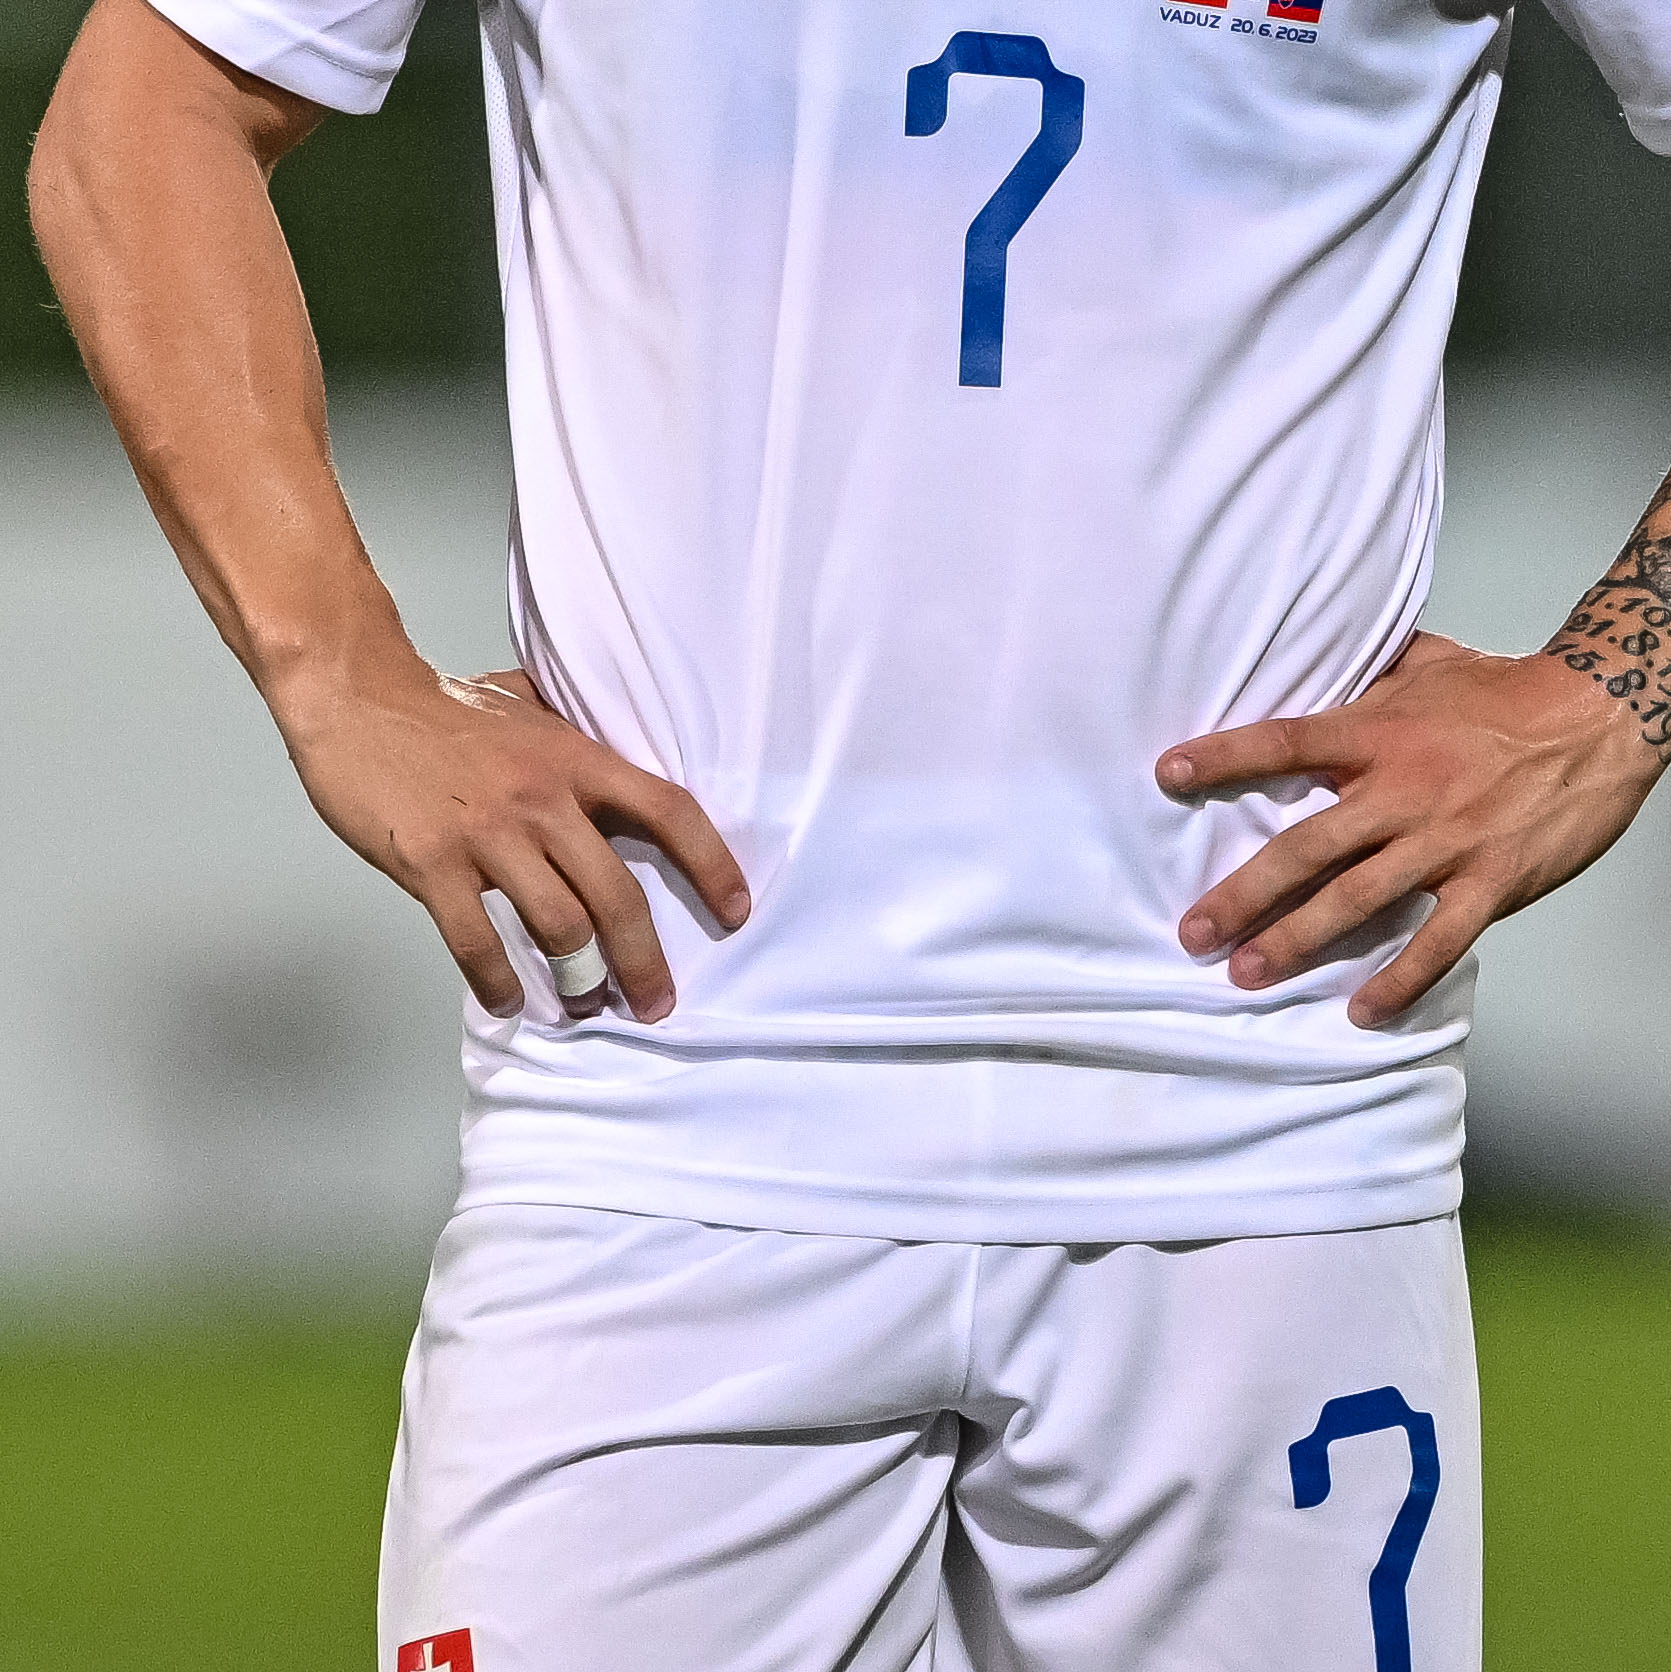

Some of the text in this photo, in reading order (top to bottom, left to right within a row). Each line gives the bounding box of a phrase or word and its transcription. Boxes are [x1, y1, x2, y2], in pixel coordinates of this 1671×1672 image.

[1159, 6, 1222, 30] VADUZ
[904, 30, 1086, 388] 7
[1288, 1385, 1442, 1672] 7
